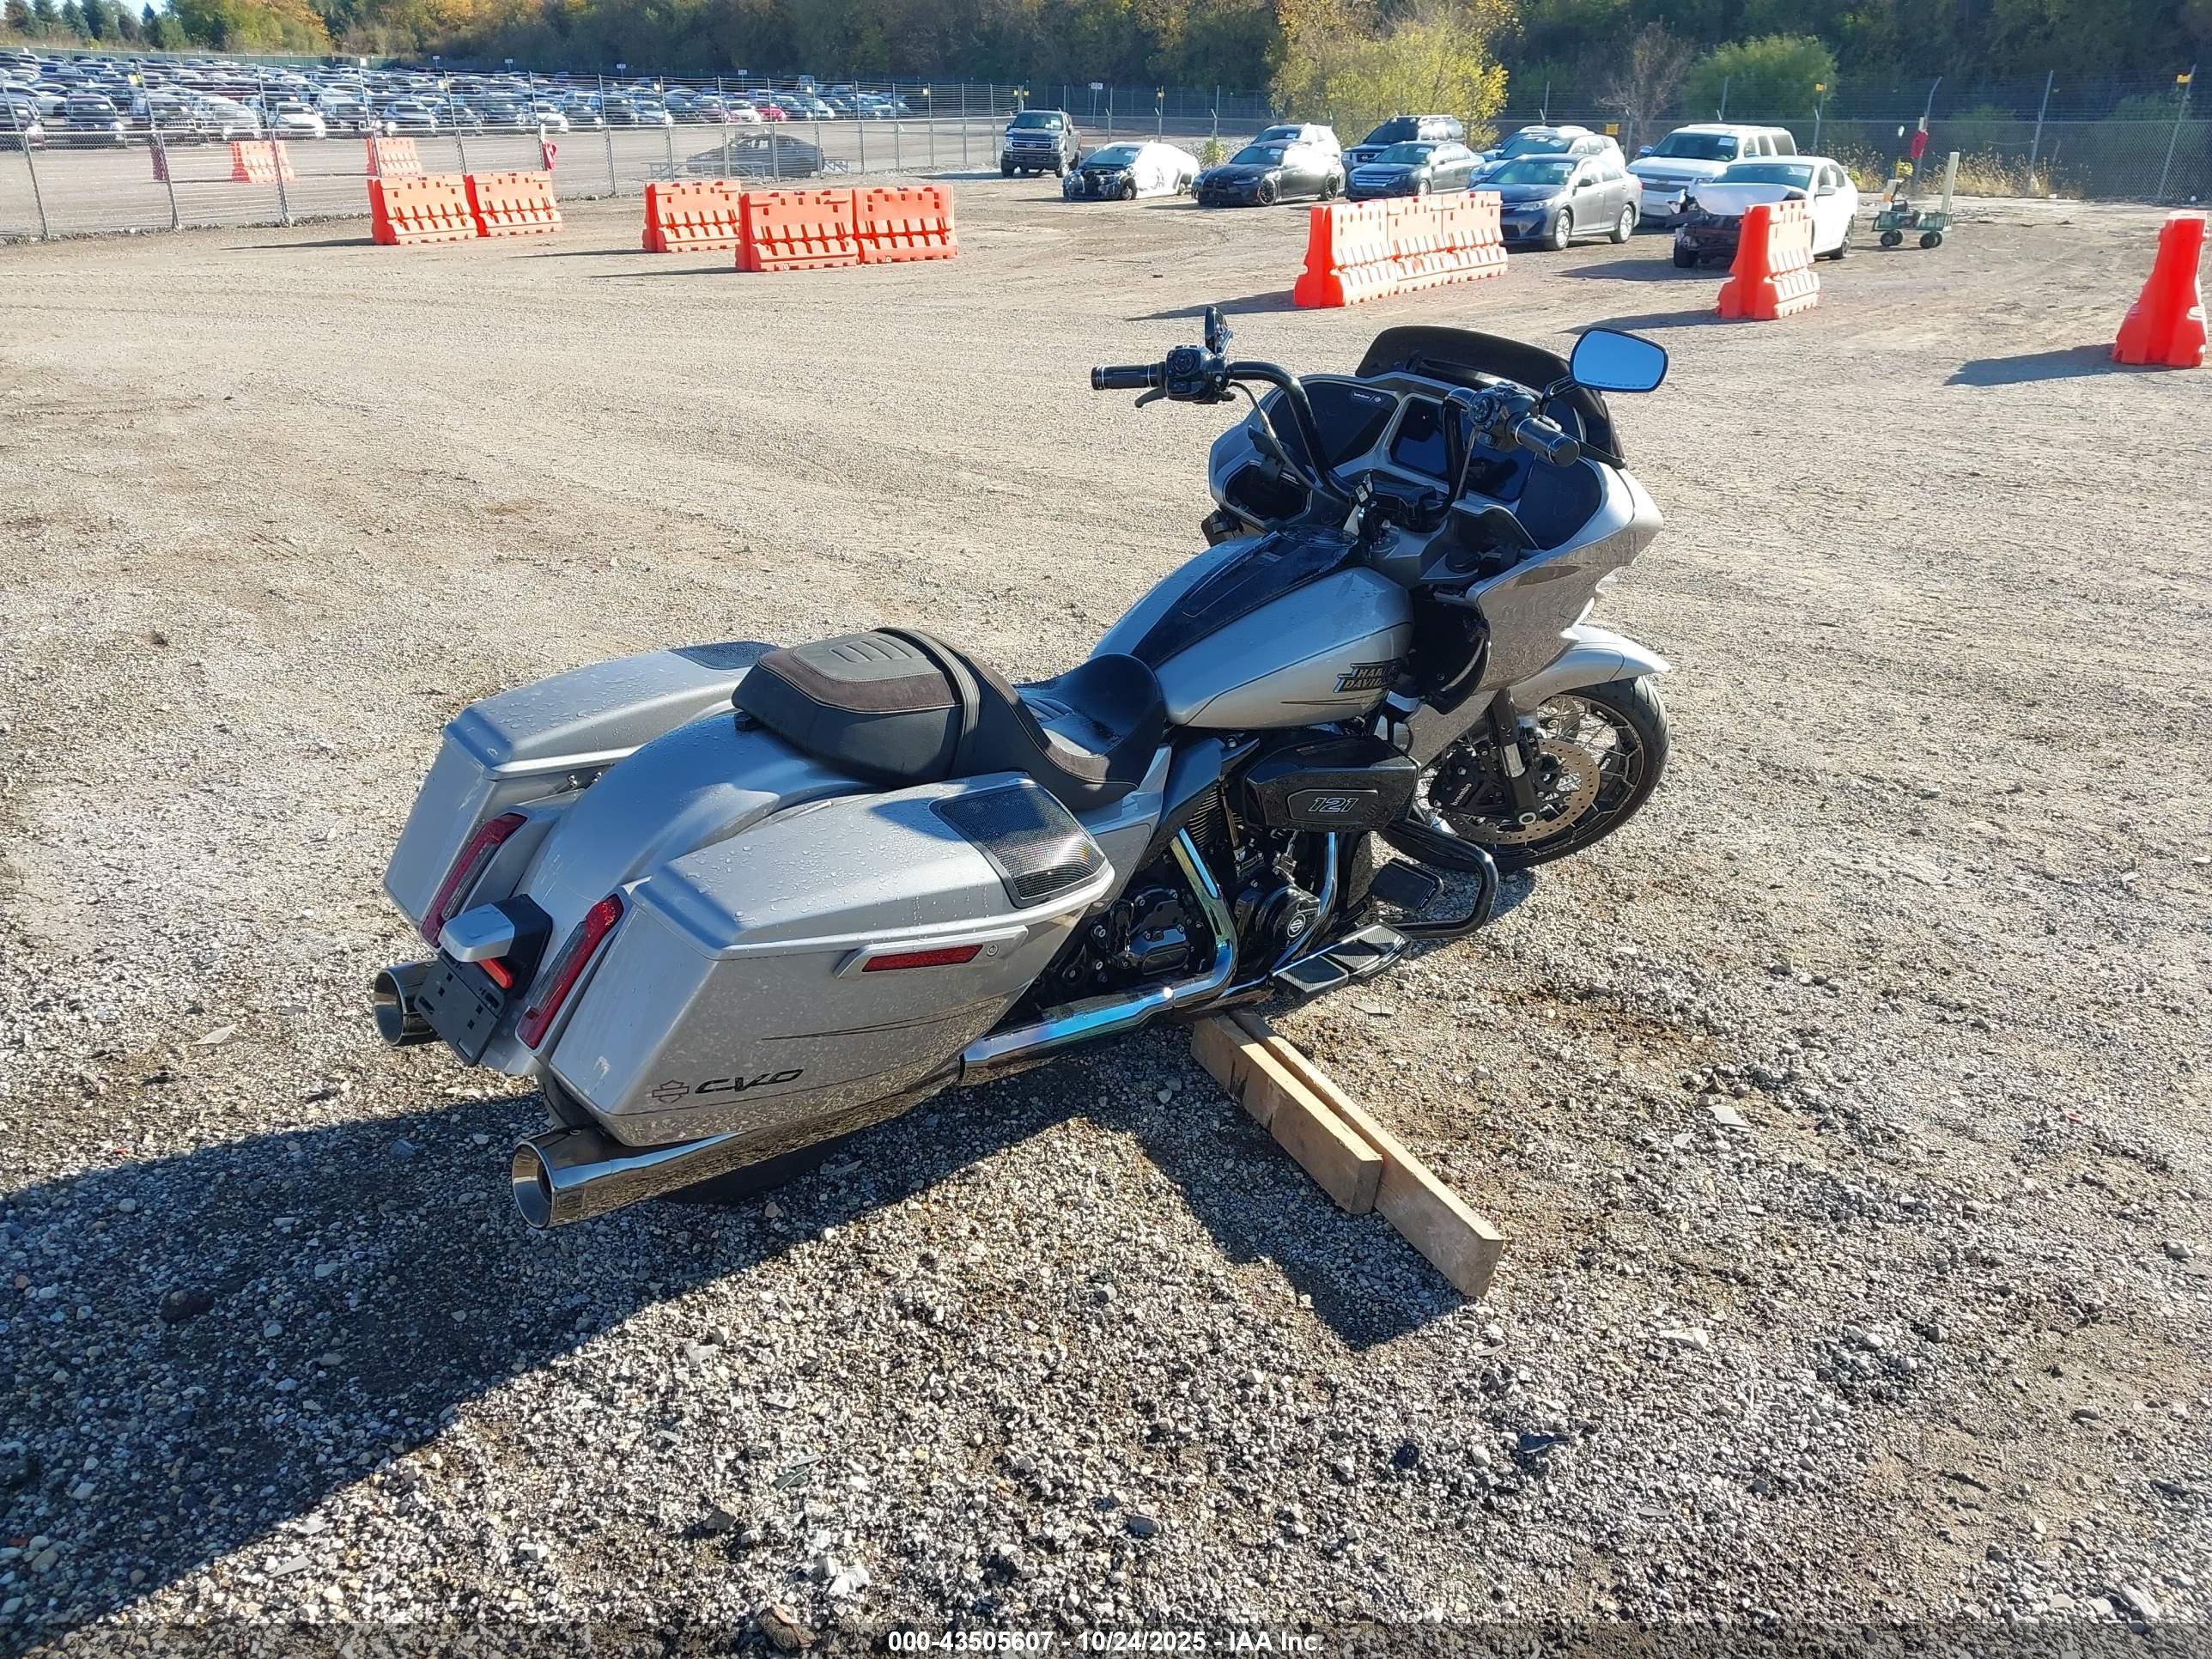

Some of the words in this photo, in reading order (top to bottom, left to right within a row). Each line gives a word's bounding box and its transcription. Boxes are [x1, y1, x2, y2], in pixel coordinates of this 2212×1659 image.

[1308, 797, 1359, 812] 121
[1449, 782, 1472, 806] brembo
[695, 1069, 805, 1094] CVO
